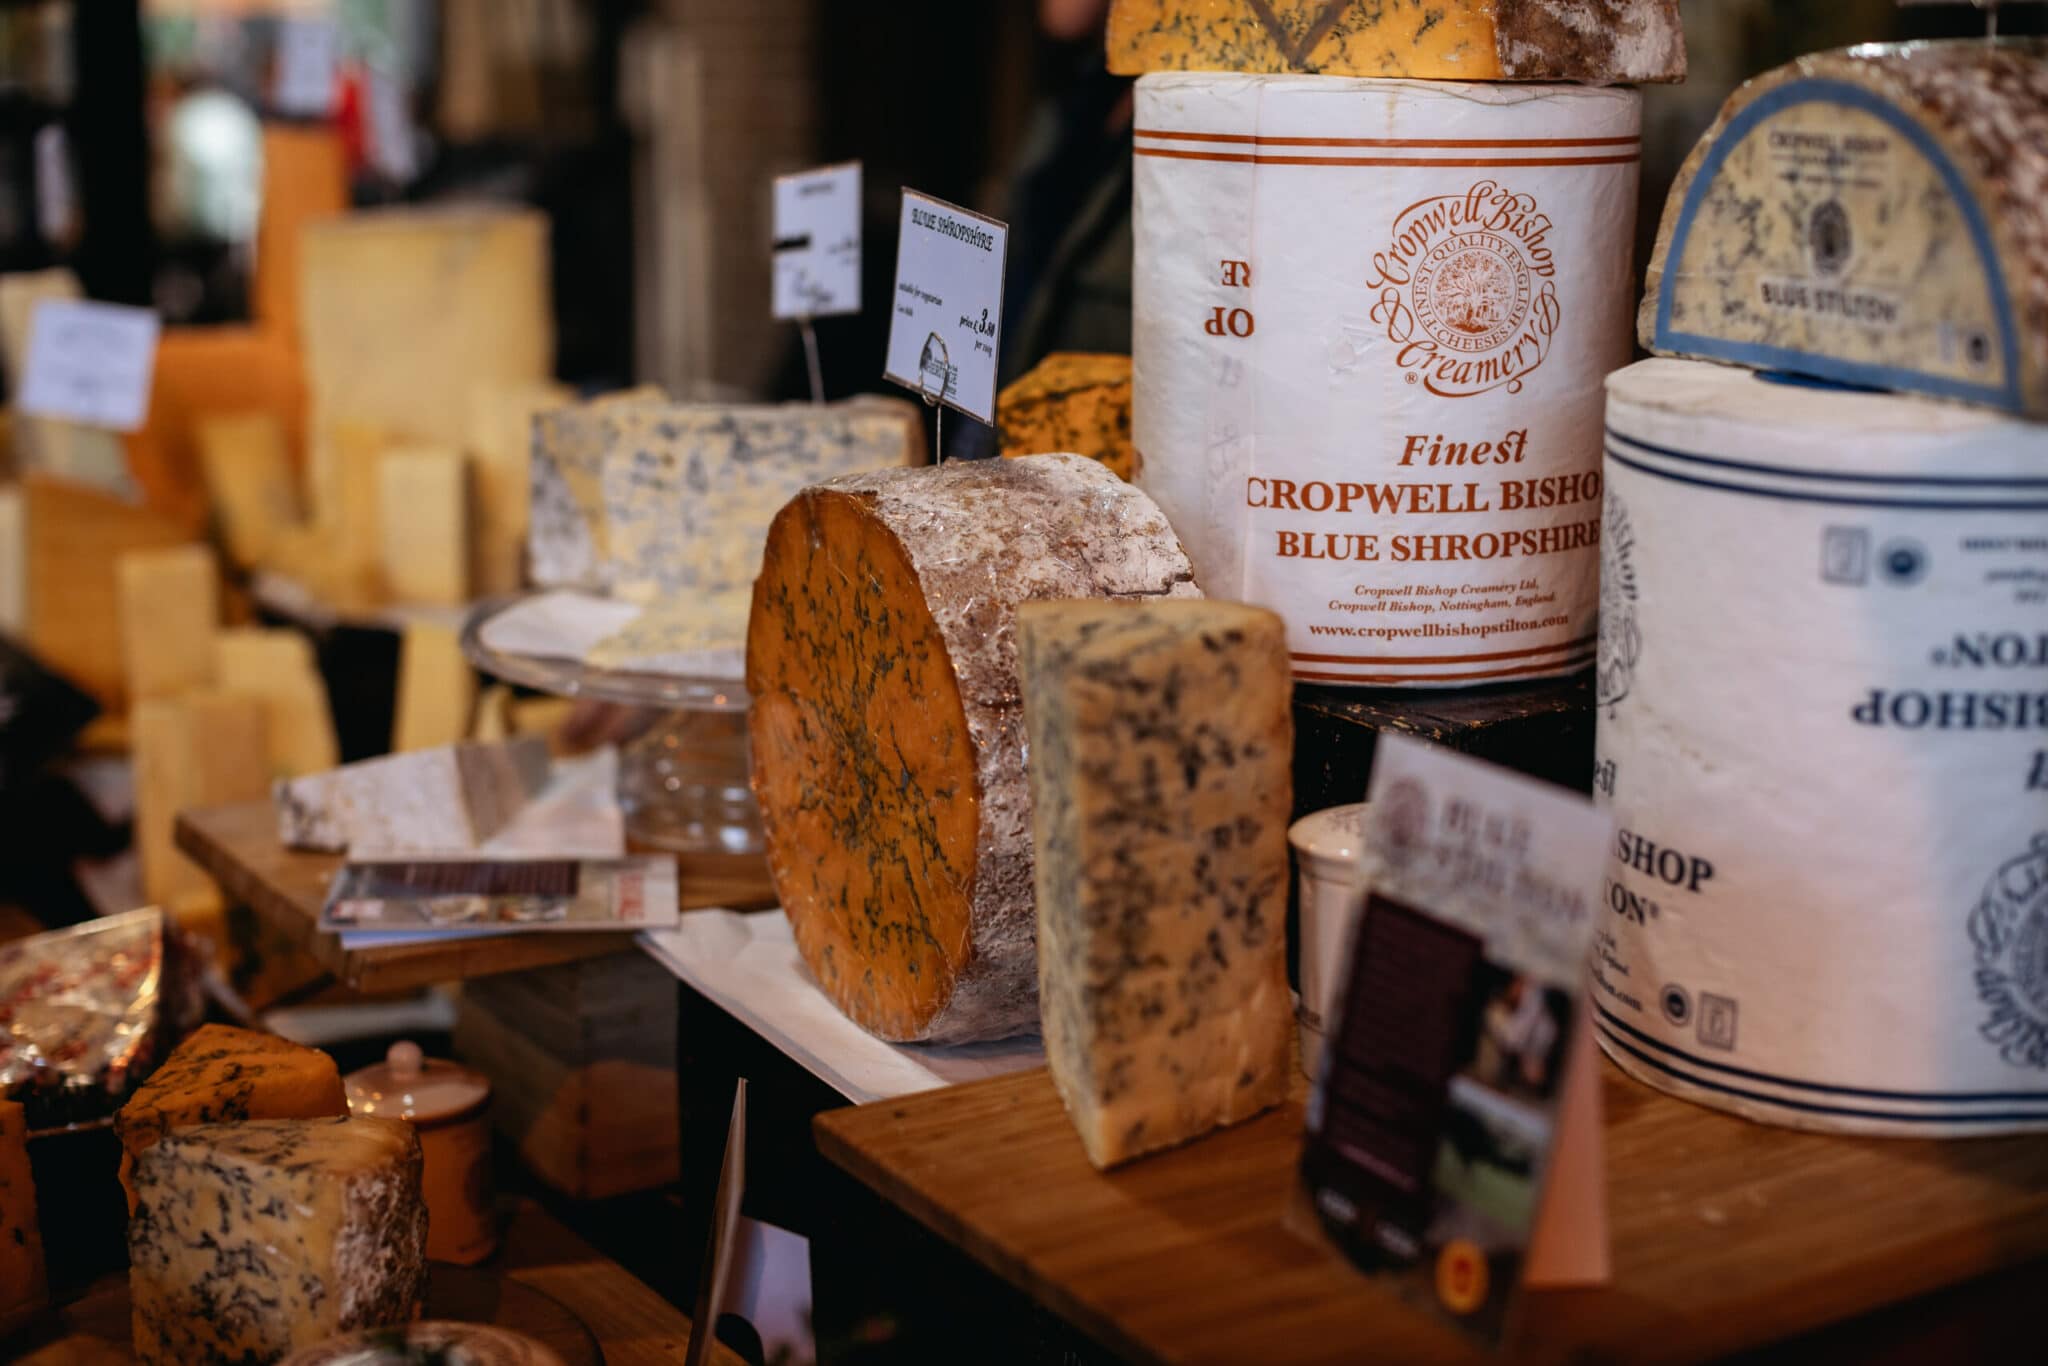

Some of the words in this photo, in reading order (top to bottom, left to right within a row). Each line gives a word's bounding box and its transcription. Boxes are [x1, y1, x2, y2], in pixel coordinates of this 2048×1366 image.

[936, 214, 994, 252] SHROPSHIRE
[1366, 180, 1498, 289] Cropwell
[1483, 188, 1556, 277] Bishop
[1432, 234, 1508, 262] QUALITY
[1415, 264, 1434, 330] FINEST
[1506, 249, 1529, 328] ENGLISH
[1436, 328, 1510, 350] CHEESES
[1396, 319, 1541, 398] Creamery
[1397, 428, 1528, 466] Finest
[1247, 477, 1489, 514] CROPWELL
[1499, 471, 1600, 511] BISHO
[1276, 530, 1379, 561] BLUE
[1391, 519, 1601, 562] SHROPSHIRE
[1328, 600, 1387, 614] Cropwell
[1389, 601, 1436, 614] Bishop,
[1439, 599, 1512, 612] Nottingham,
[1354, 584, 1412, 599] Cropwell
[1415, 584, 1457, 598] Bishop
[1461, 583, 1517, 595] Creamery
[1309, 614, 1569, 642] www.cropwellbishopstilton.com
